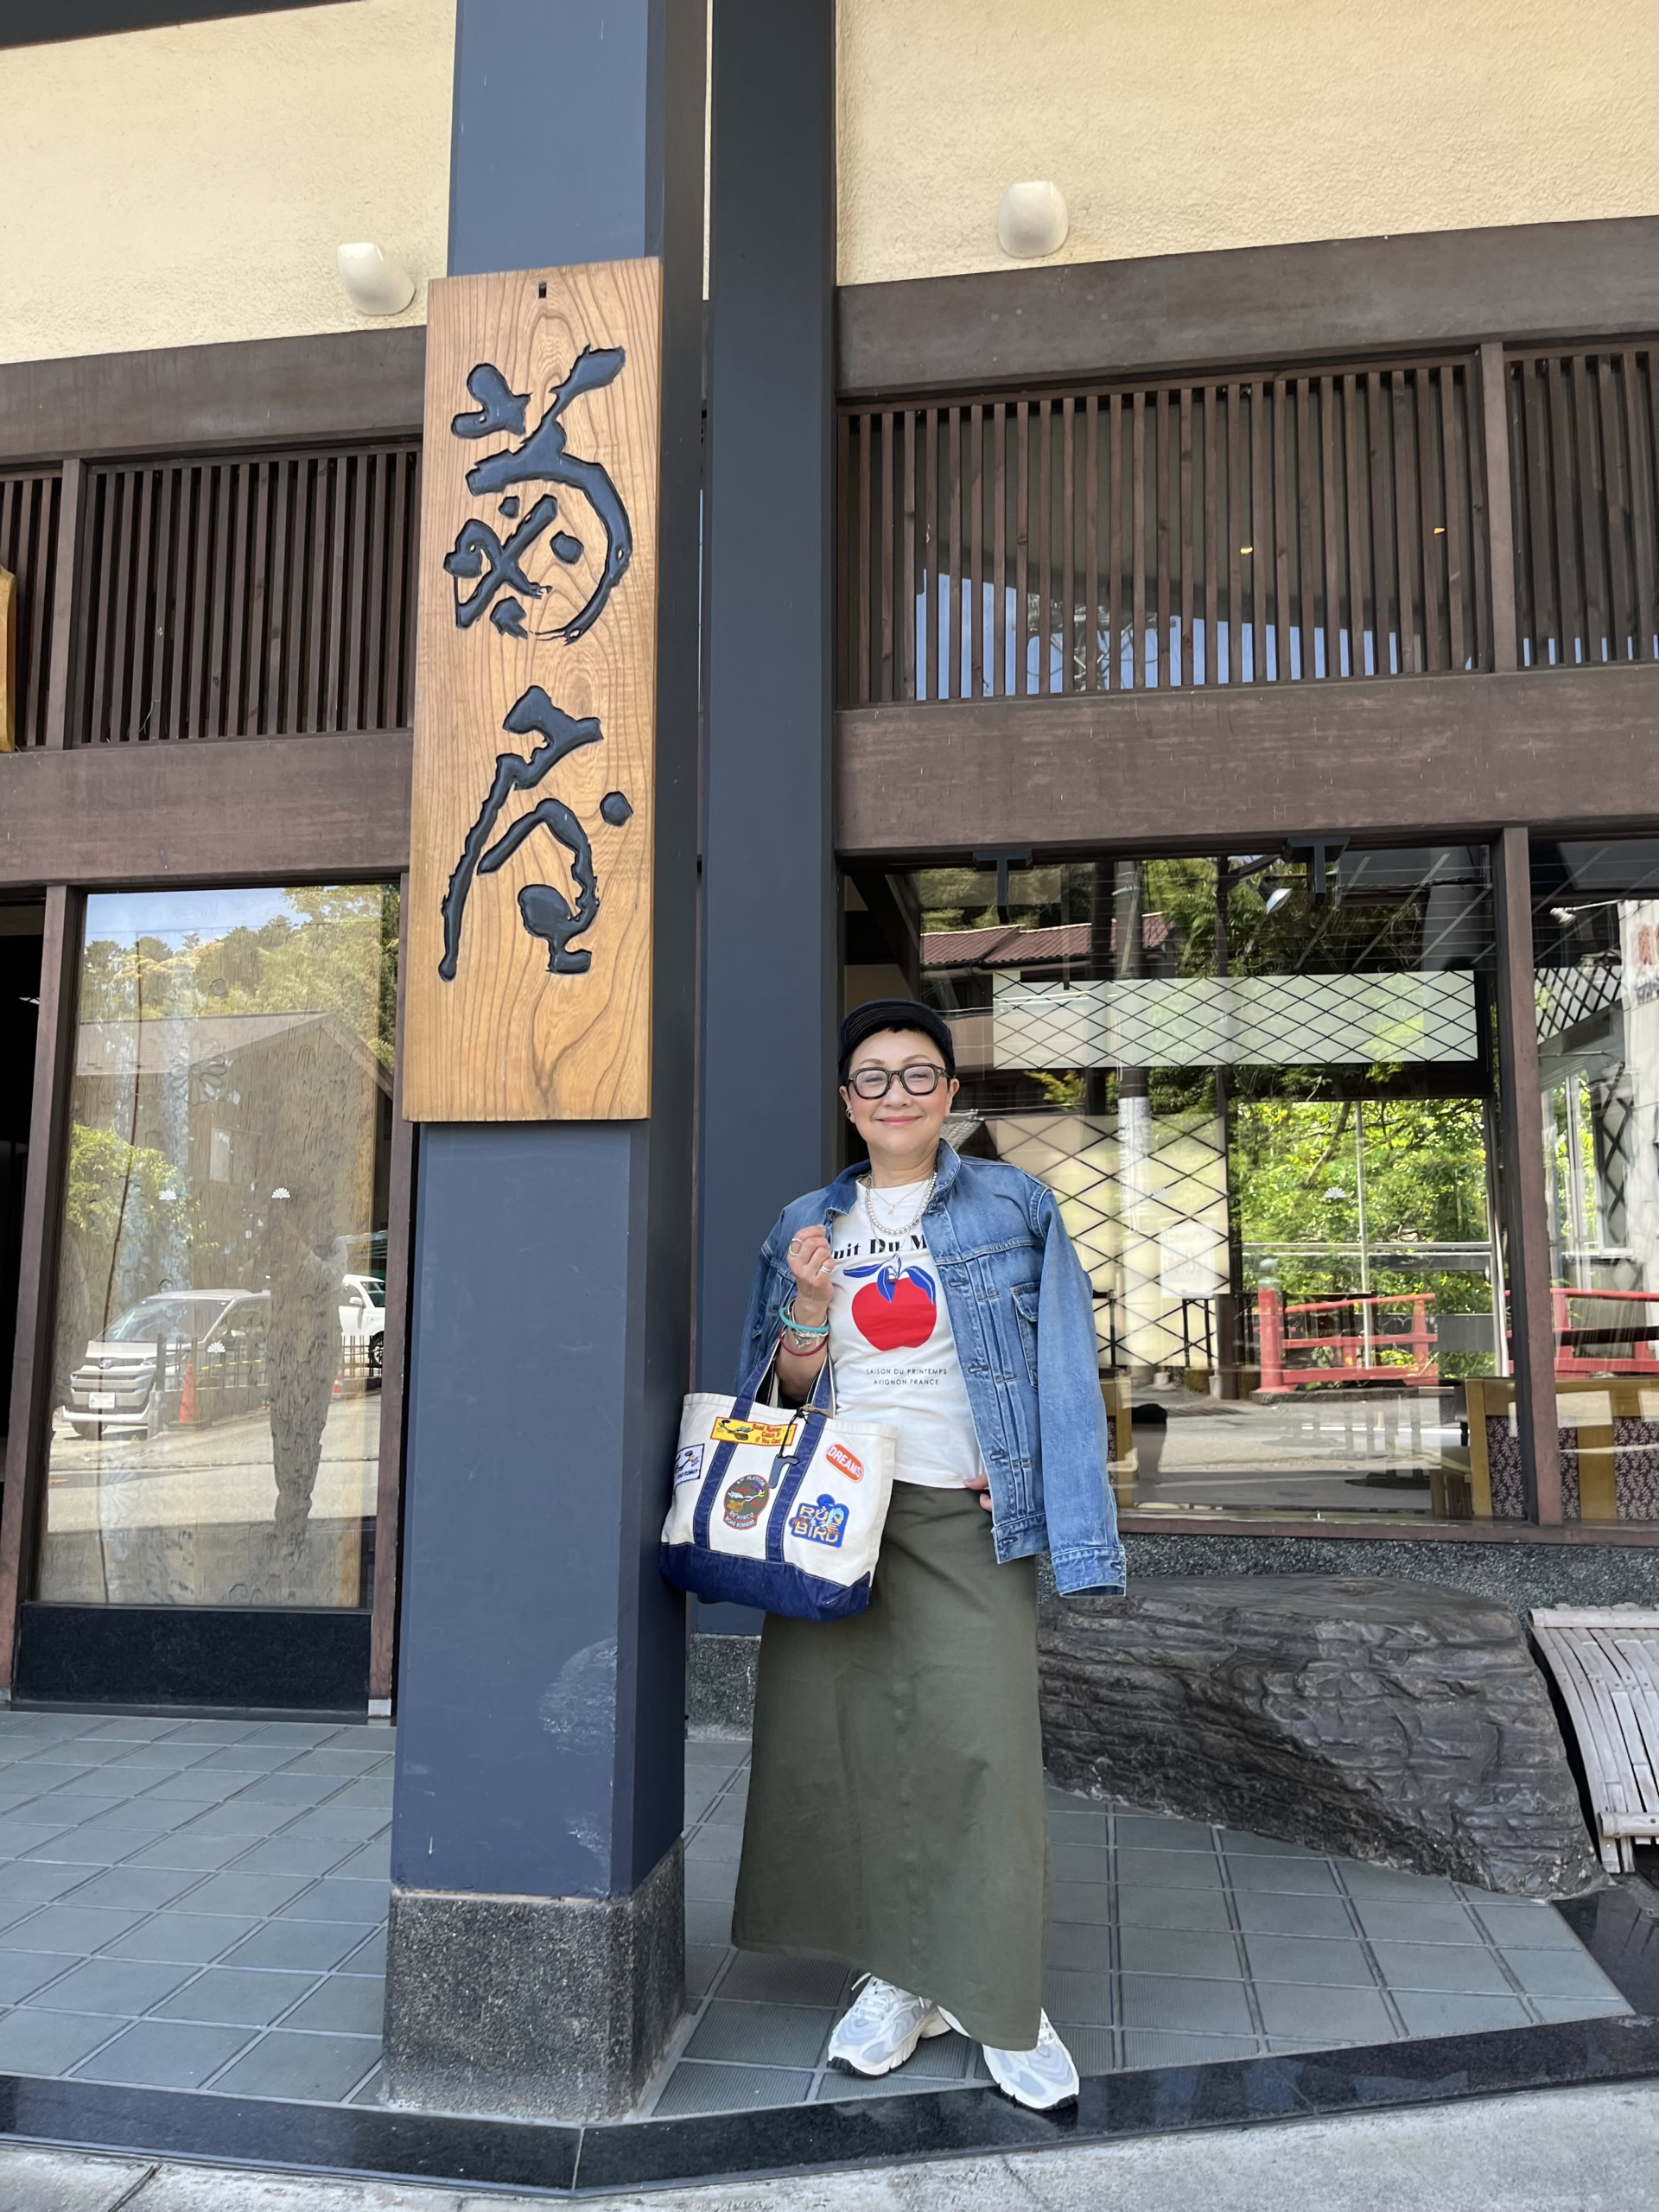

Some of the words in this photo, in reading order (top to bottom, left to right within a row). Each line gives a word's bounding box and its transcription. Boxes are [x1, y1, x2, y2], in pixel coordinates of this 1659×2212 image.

[870, 1238, 900, 1254] Du
[827, 1446, 861, 1478] DREAMS
[794, 1521, 839, 1542] BIRD
